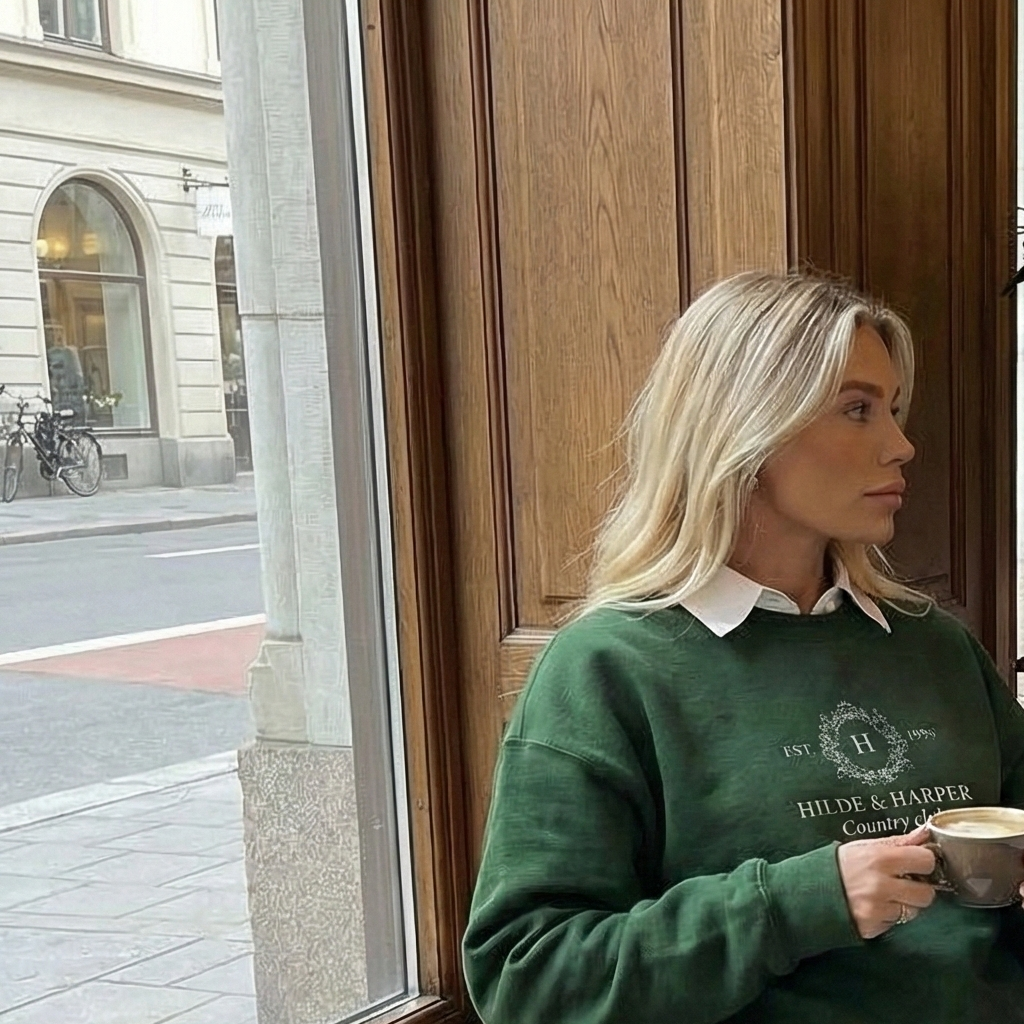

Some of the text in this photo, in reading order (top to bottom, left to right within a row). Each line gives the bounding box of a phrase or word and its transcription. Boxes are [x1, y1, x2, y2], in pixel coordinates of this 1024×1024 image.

[850, 732, 876, 756] H
[797, 784, 974, 819] HILDE & HARPER
[842, 806, 941, 836] Country cl
